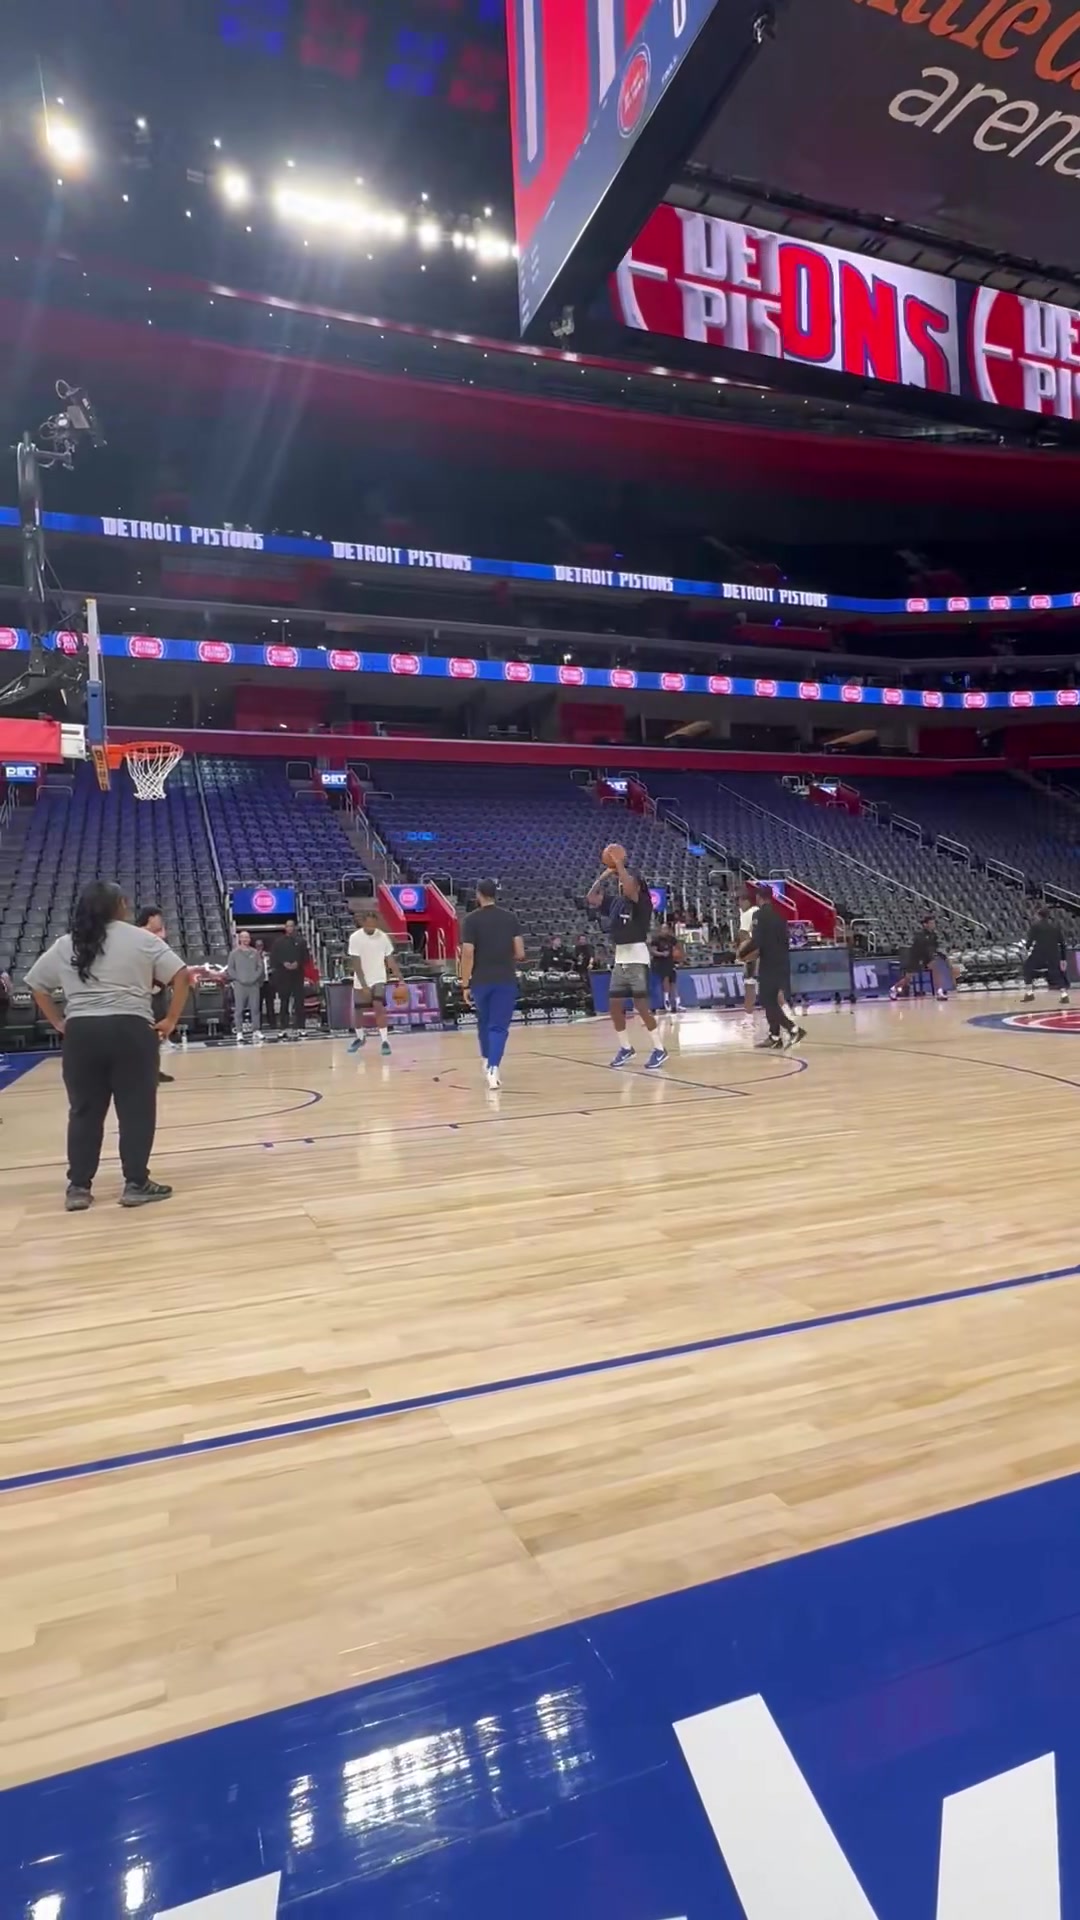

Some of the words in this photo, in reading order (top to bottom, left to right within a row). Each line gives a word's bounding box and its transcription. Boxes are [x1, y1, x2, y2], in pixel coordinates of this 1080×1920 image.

[101, 516, 182, 542] DETROIT
[189, 526, 264, 550] PISTONS
[331, 541, 401, 564] DETROIT
[408, 549, 472, 571] PISTONS
[554, 565, 612, 586] DETROIT
[619, 572, 674, 592] PISTONS
[722, 583, 774, 603] DETROIT
[778, 589, 828, 608] PISTONS
[5, 766, 37, 778] DET
